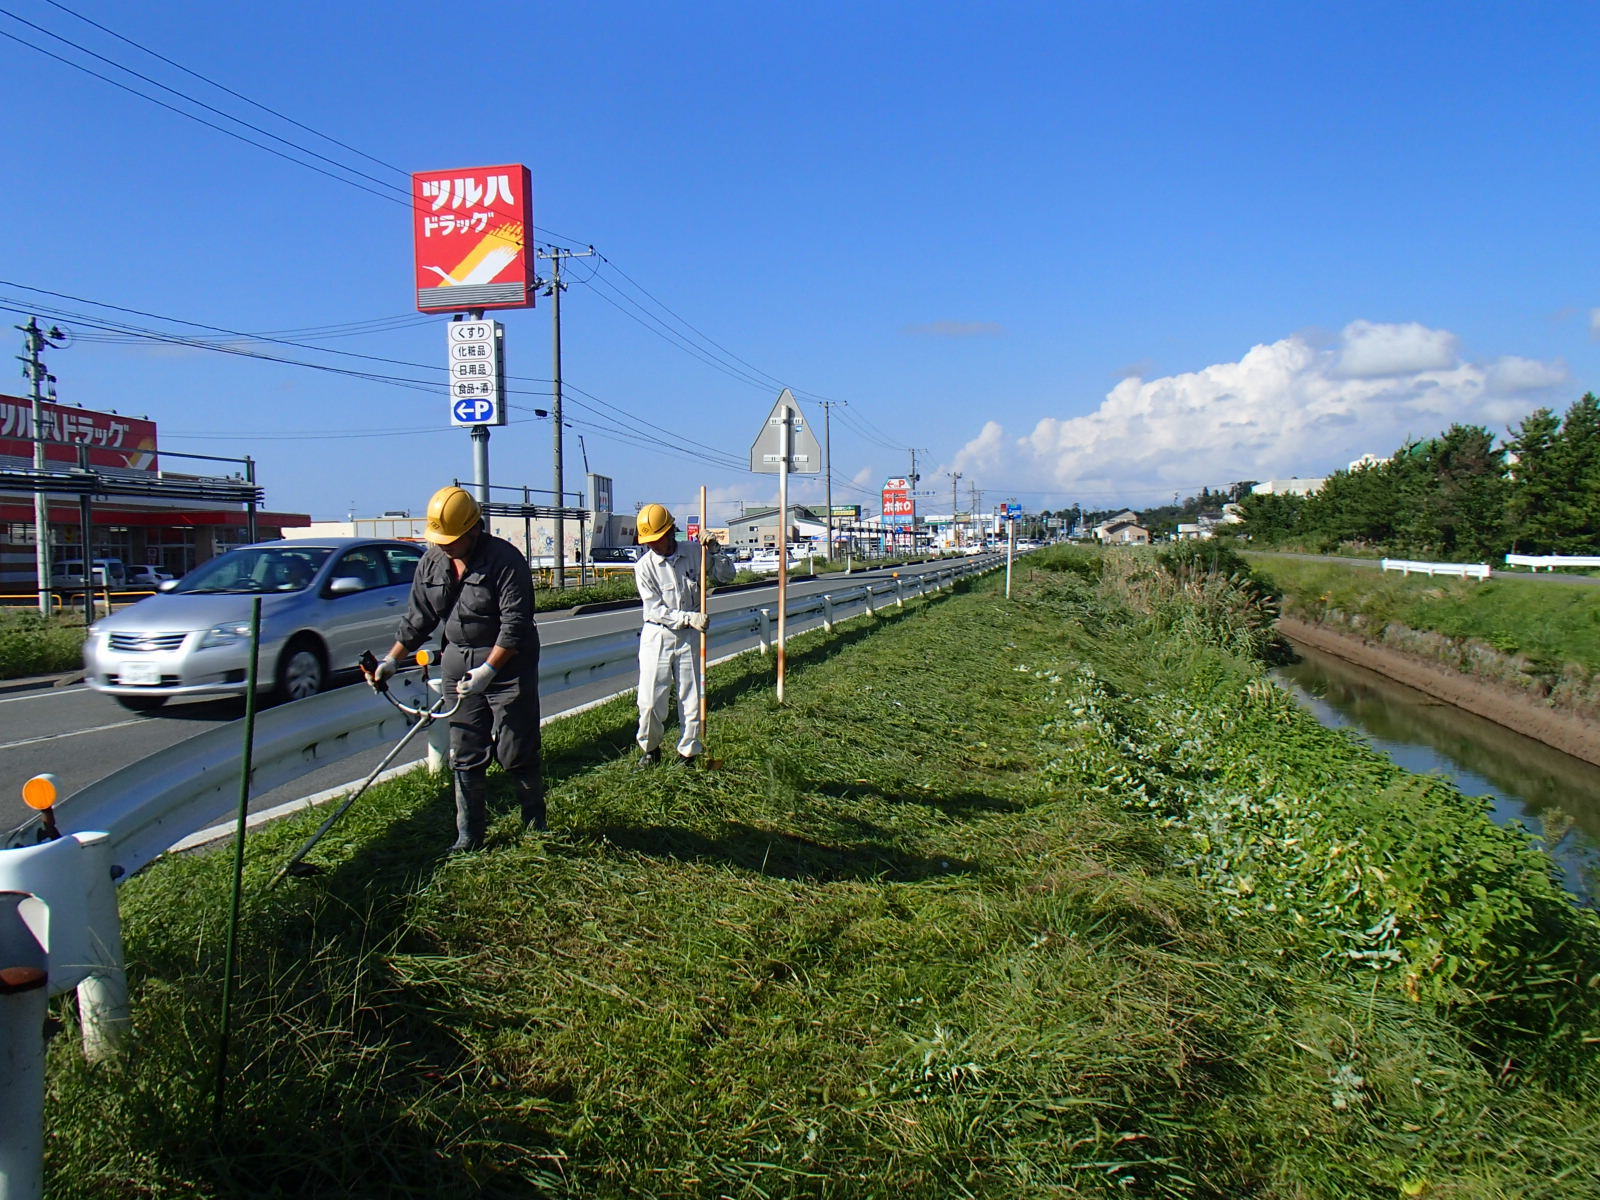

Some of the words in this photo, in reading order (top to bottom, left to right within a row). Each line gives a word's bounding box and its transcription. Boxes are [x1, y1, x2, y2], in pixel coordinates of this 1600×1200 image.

[422, 175, 514, 211] ツルハ
[424, 212, 494, 237] ドラッグ
[458, 327, 485, 338] くすり
[458, 345, 486, 357] 化粧品
[459, 364, 487, 376] 日用品
[475, 401, 488, 420] P
